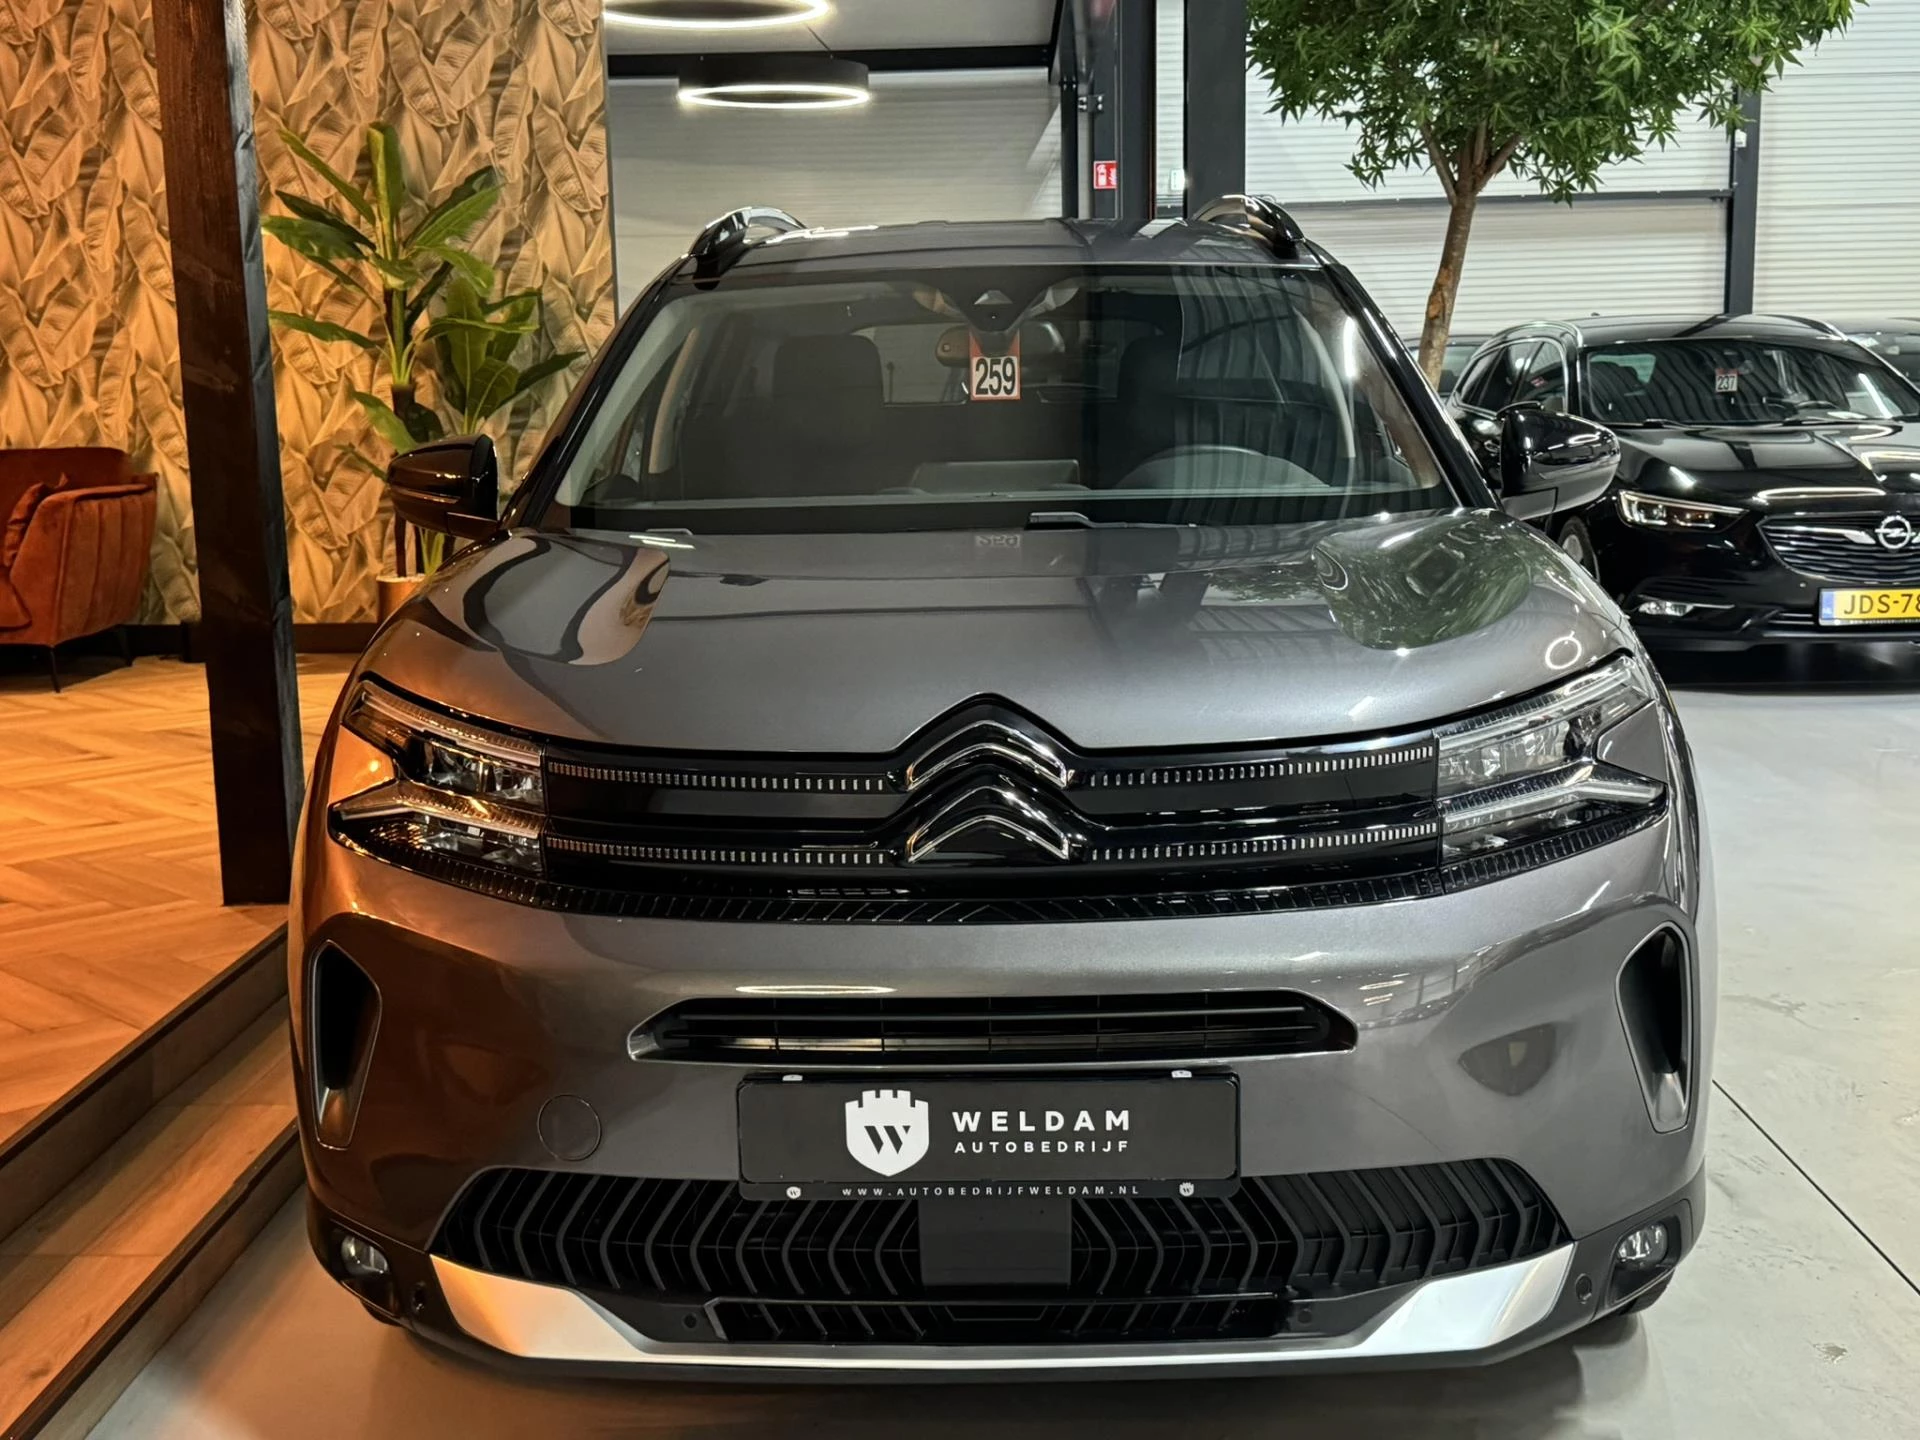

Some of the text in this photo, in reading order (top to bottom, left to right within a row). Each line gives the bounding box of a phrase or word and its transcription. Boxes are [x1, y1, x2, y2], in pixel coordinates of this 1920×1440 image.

[975, 357, 1016, 396] 259
[952, 1110, 1130, 1132] WELDAM
[954, 1140, 1128, 1154] AUTOBEDRIJF
[842, 1185, 1139, 1196] WWW.AUTOBEDRIJFWELDAM.NL
